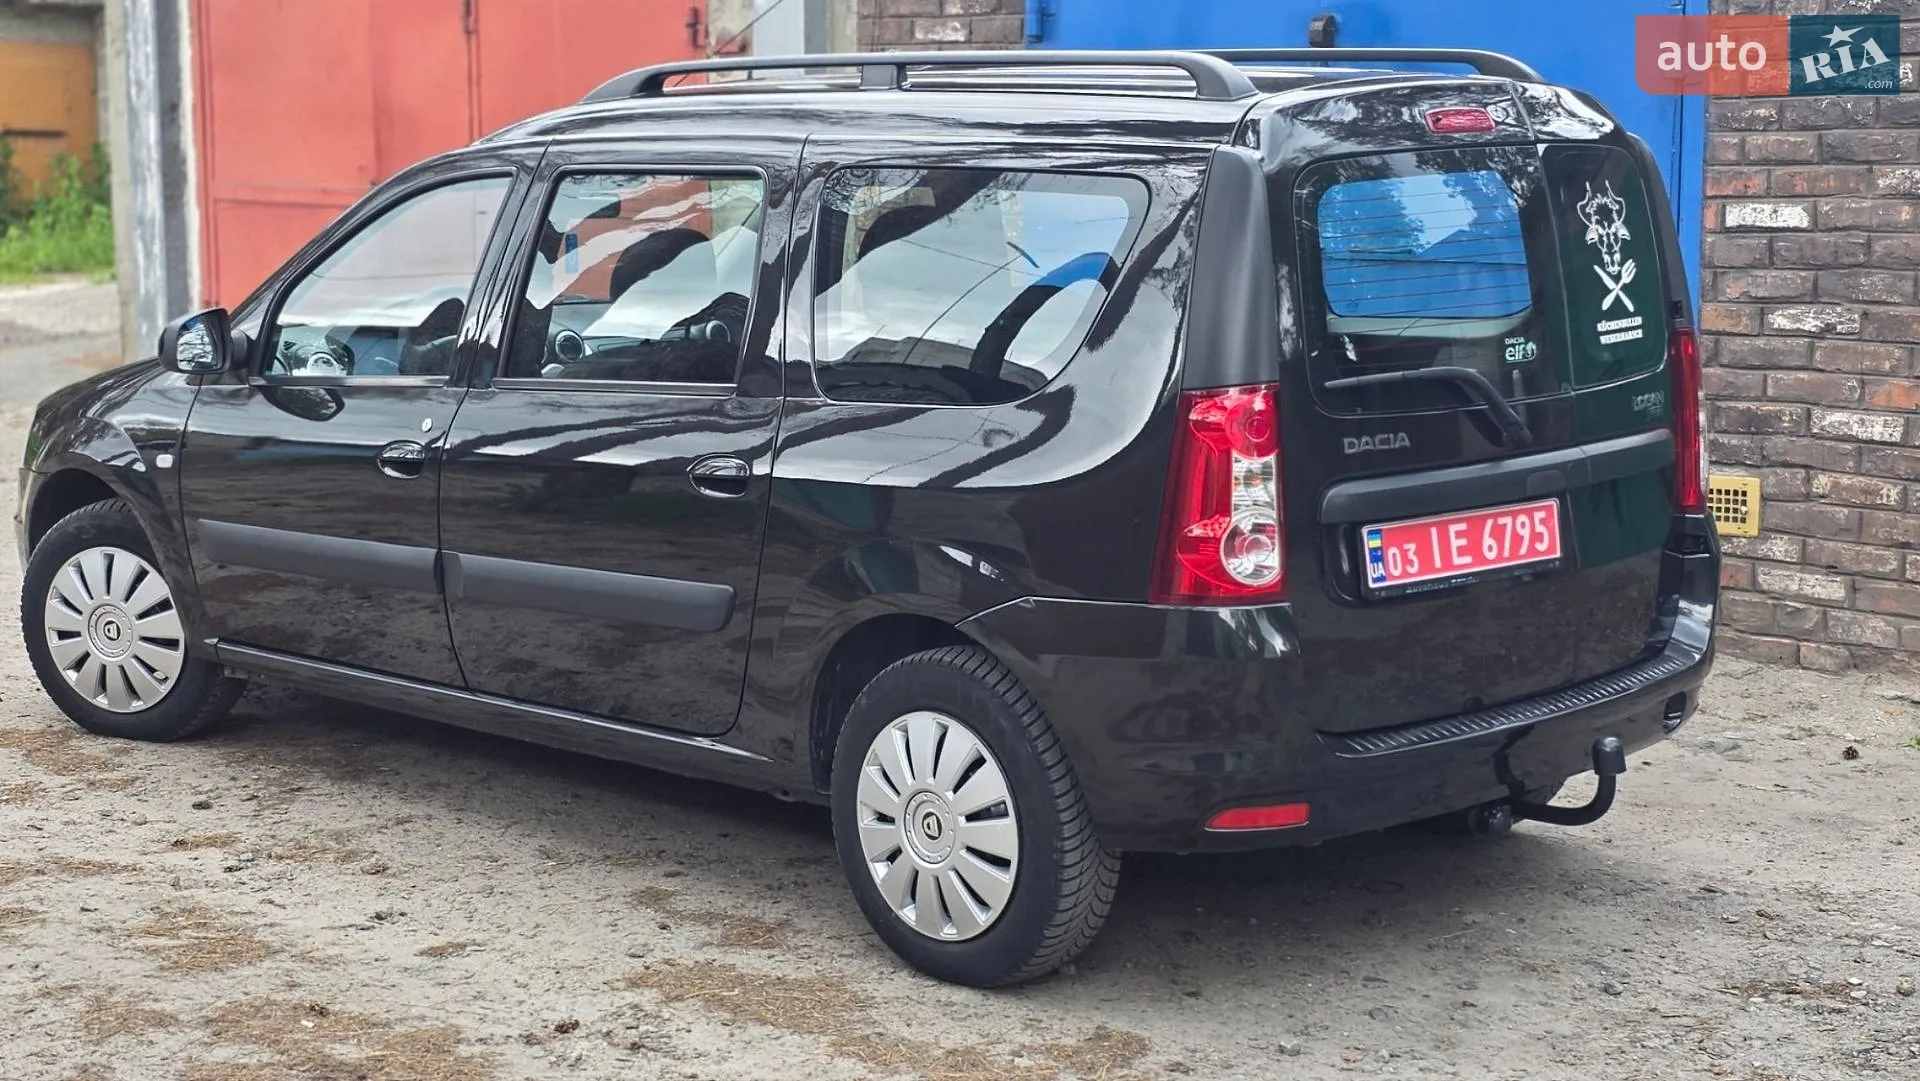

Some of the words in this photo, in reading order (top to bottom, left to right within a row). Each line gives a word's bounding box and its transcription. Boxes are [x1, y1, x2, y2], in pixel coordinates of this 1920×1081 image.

[1505, 344, 1525, 361] elf
[1343, 432, 1411, 454] DACIA
[1387, 543, 1419, 577] 03
[1430, 522, 1473, 569] IE
[1482, 511, 1550, 561] 6795
[1371, 561, 1386, 578] UA
